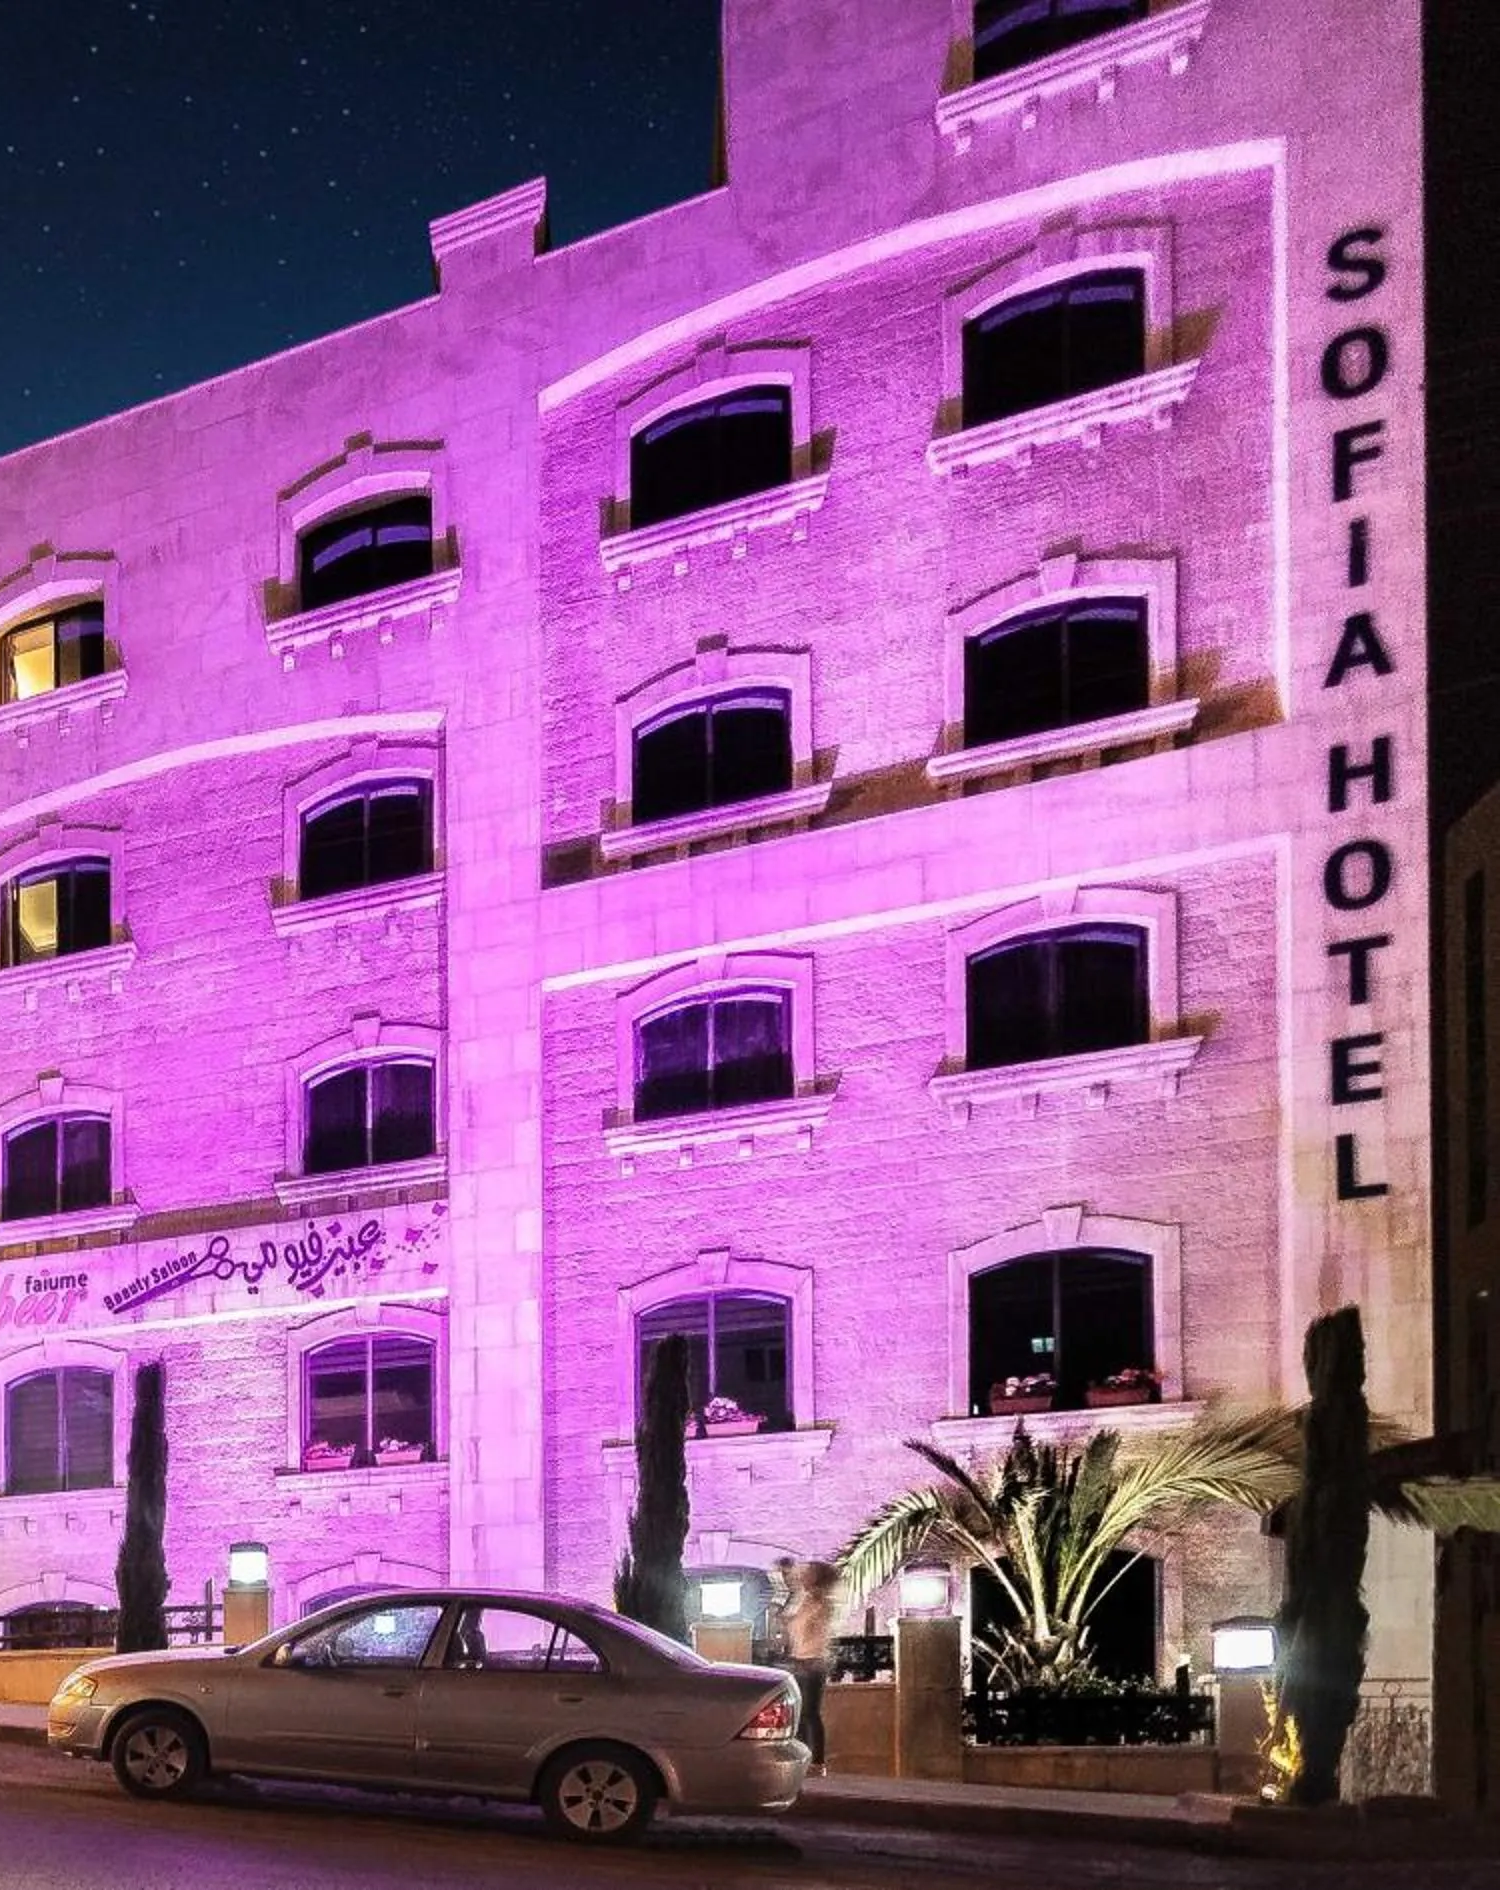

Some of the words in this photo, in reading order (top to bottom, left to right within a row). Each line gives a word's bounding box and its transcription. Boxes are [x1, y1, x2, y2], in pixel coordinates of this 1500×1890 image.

[1321, 228, 1395, 688] SOFIA
[1324, 736, 1392, 1200] HOTEL
[25, 1270, 88, 1293] faiume
[103, 1275, 150, 1310] Beauty
[150, 1251, 197, 1284] Saloon
